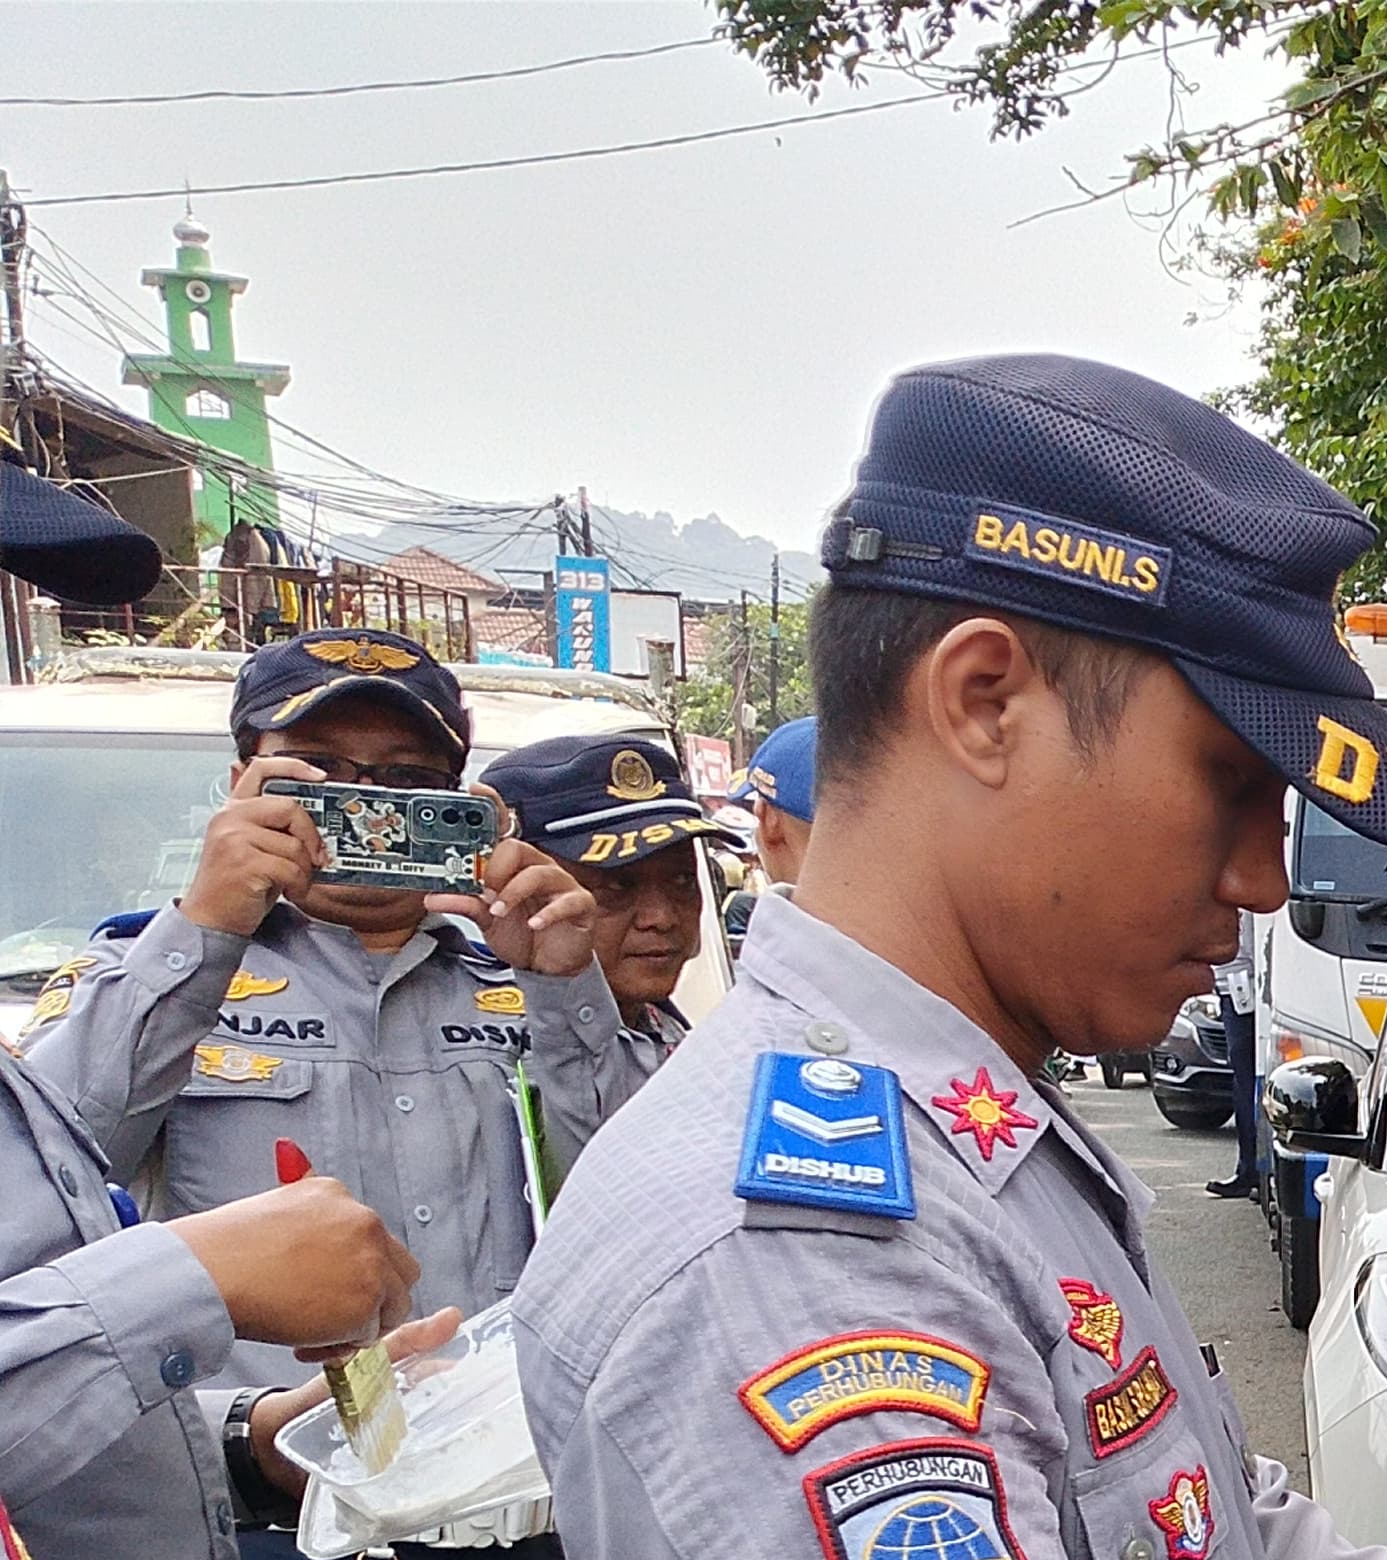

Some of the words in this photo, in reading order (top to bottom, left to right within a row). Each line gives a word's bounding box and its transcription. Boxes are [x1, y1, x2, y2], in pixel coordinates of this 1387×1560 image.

[559, 571, 605, 591] 313
[217, 1011, 326, 1041] NJAR
[766, 1153, 887, 1186] DISHUB
[818, 1351, 933, 1382] DINAS
[787, 1371, 963, 1420] PERHUBUNGAN
[832, 1456, 984, 1504] PERHUBUNGAN
